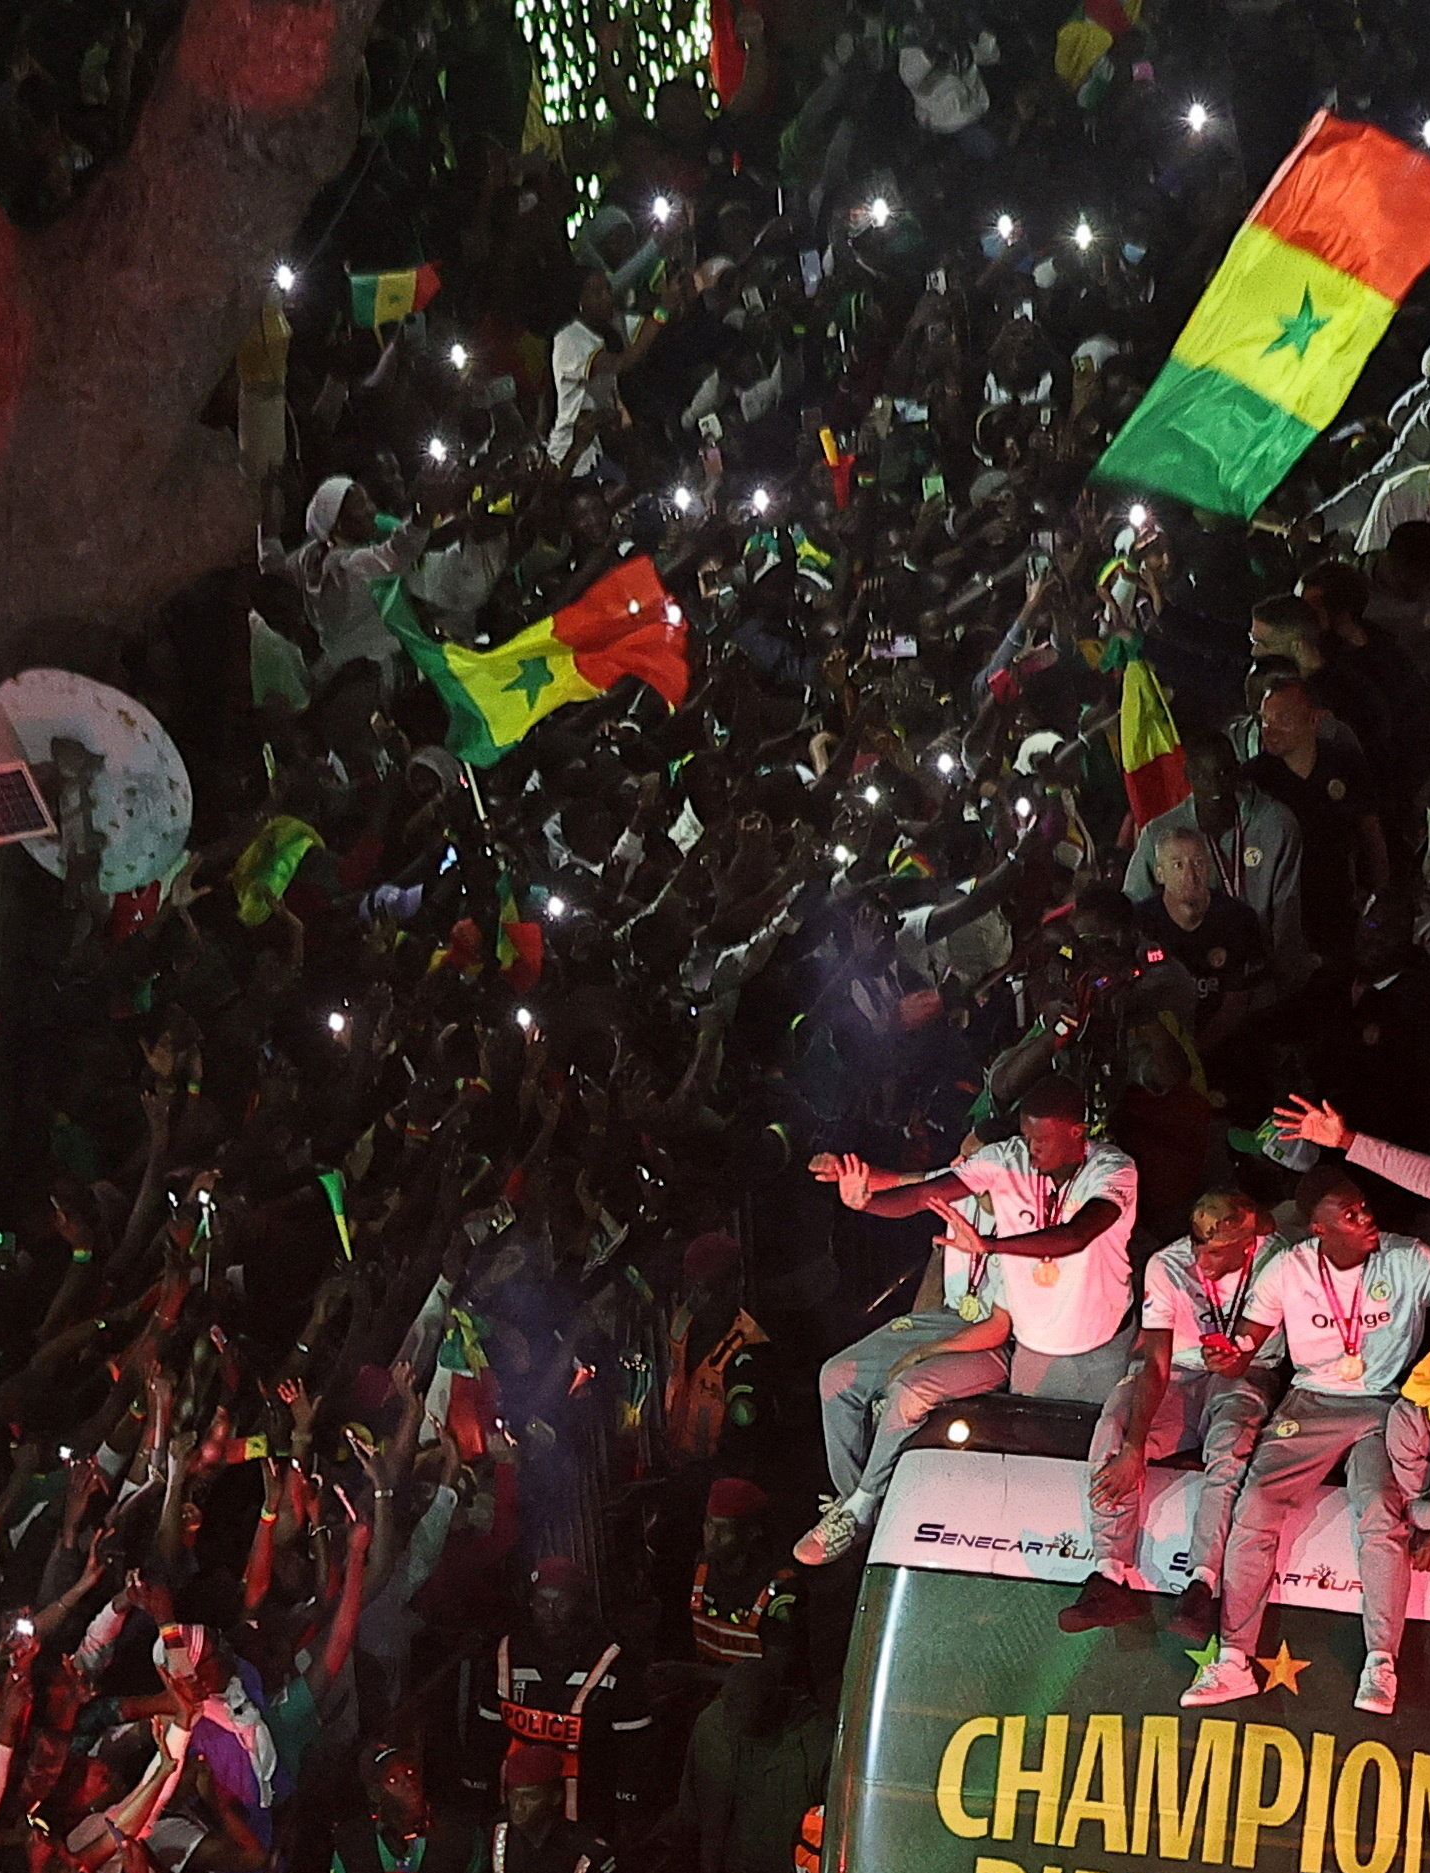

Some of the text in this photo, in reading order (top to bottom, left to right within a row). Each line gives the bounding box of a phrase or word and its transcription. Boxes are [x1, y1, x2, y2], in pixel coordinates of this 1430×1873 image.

[1311, 1310, 1390, 1330] Orge
[914, 1522, 1095, 1561] SENECARTOU
[503, 1706, 578, 1740] POLICE
